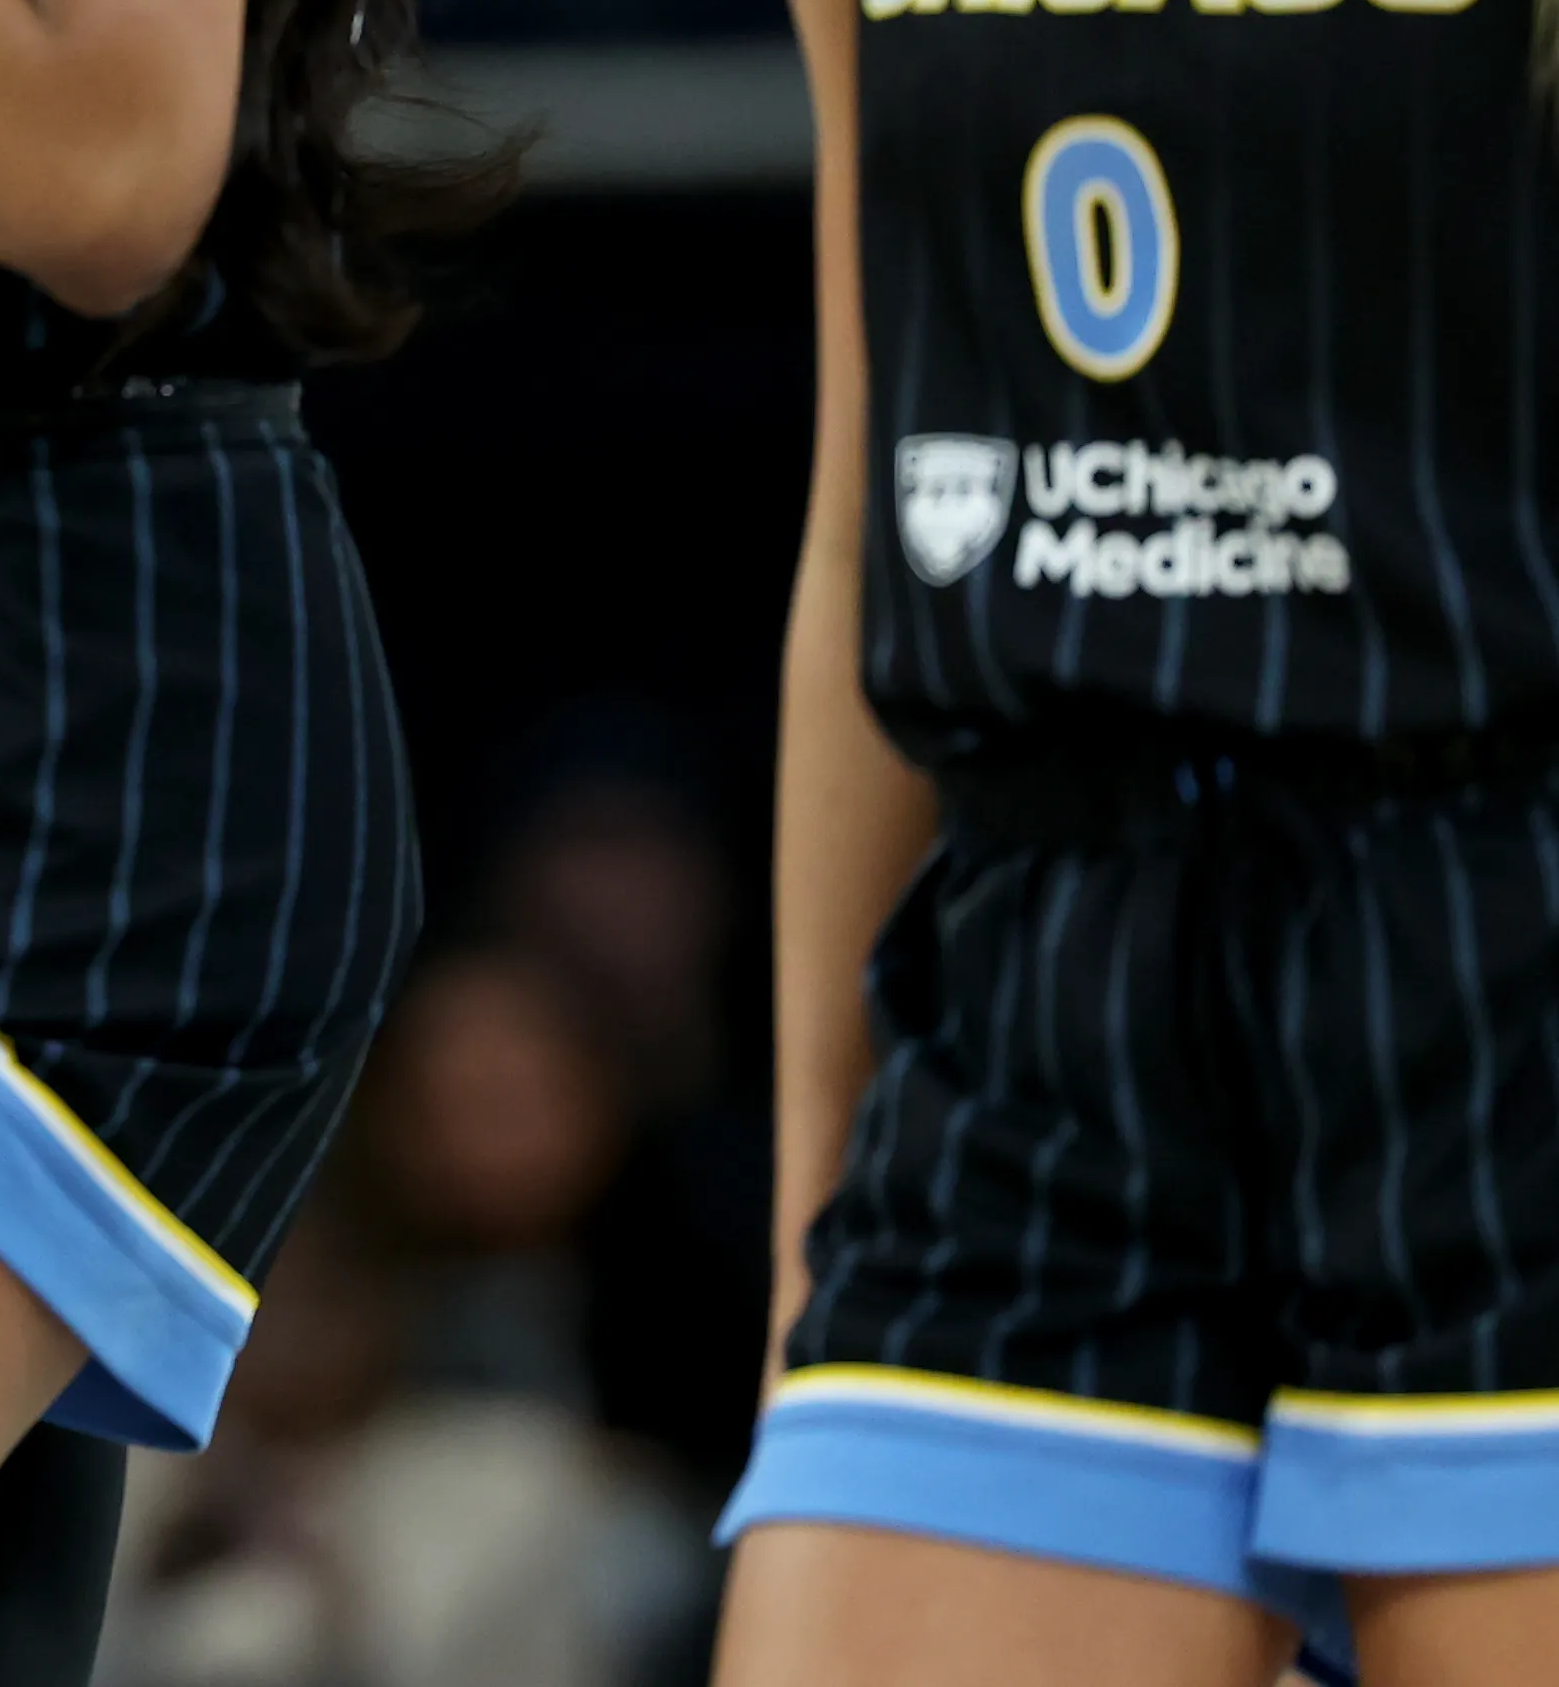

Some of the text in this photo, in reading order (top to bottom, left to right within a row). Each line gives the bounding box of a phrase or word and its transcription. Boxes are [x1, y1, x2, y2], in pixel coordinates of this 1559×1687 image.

[1022, 115, 1179, 382] 0
[1022, 437, 1337, 529] UChicago
[1013, 515, 1351, 599] Medicine
